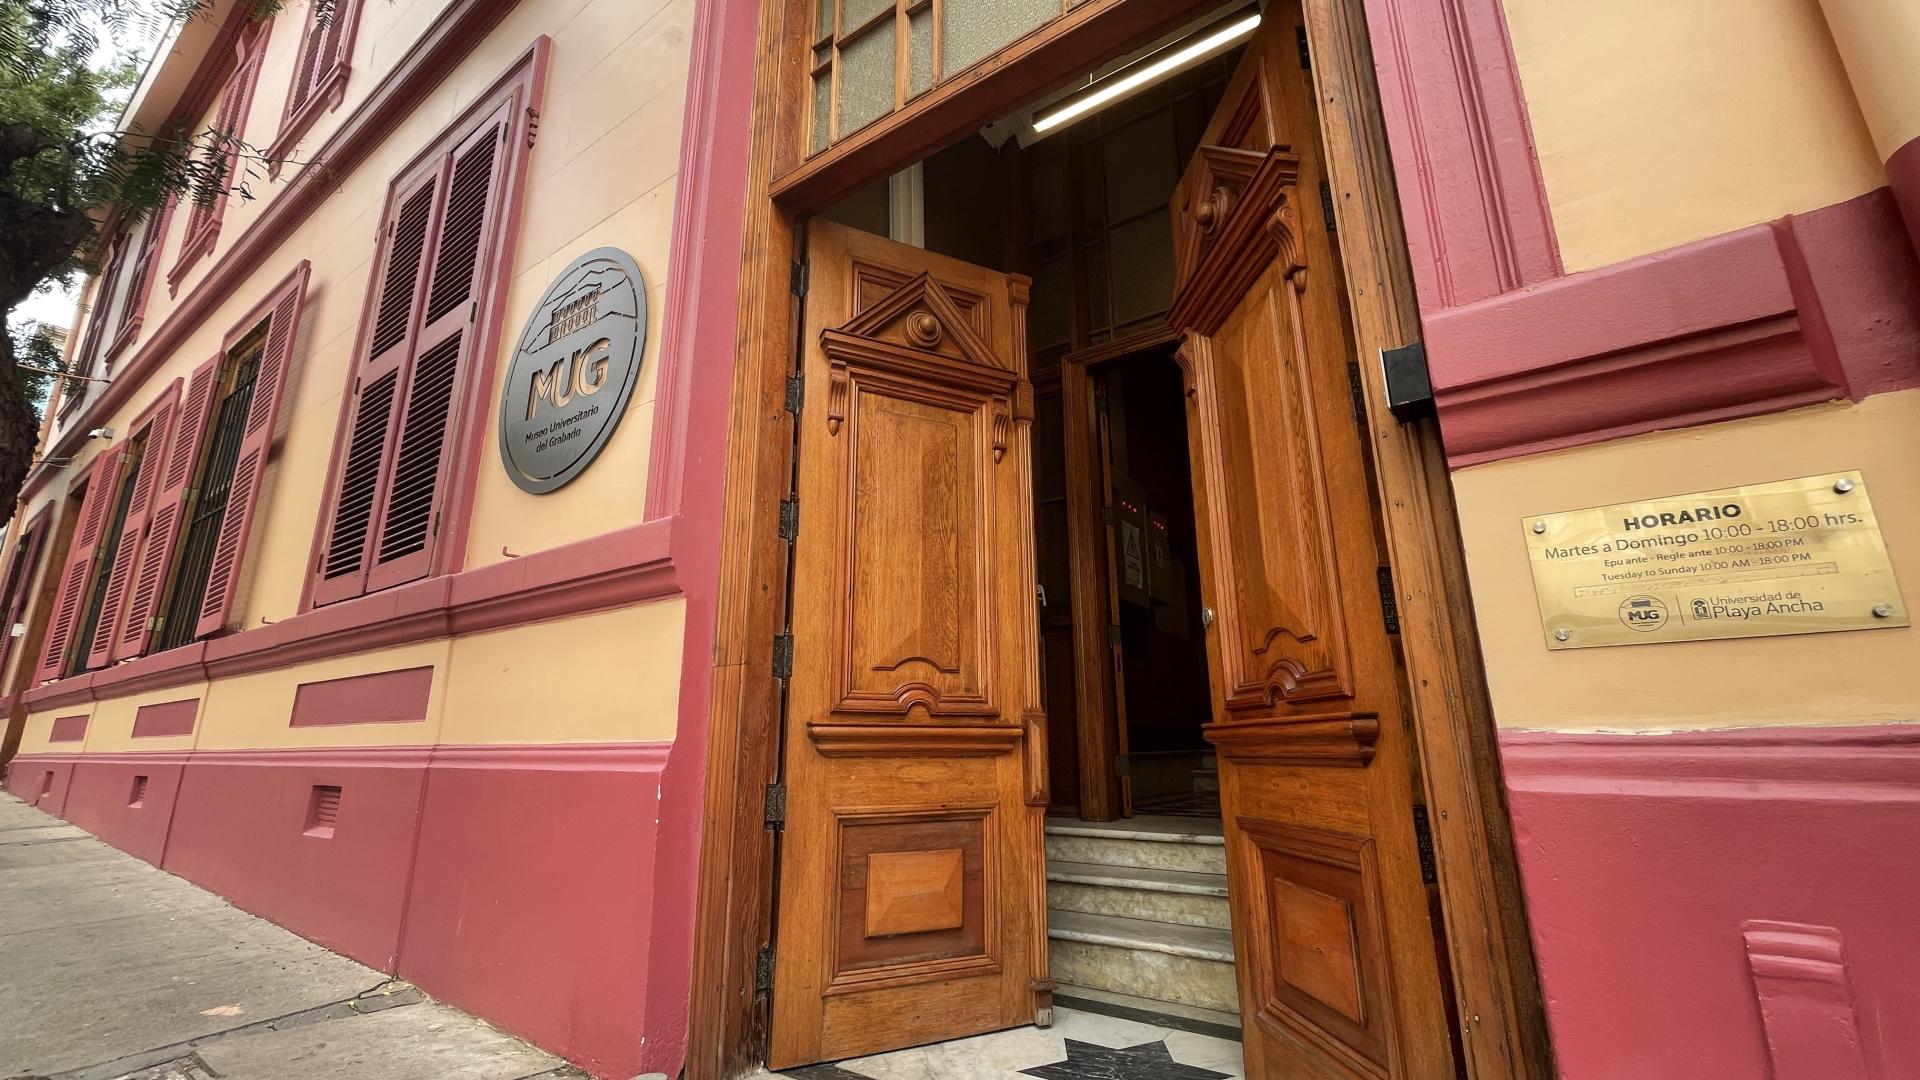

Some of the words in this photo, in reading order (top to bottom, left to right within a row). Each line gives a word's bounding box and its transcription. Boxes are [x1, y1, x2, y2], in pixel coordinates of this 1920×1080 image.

[525, 337, 611, 422] MUG
[525, 427, 548, 444] Museo
[550, 405, 599, 433] Universitario
[536, 438, 548, 453] del
[549, 427, 581, 447] Grabado
[1623, 504, 1741, 531] HORARIO
[1545, 544, 1598, 560] Martes
[1603, 542, 1612, 553] a
[1616, 533, 1699, 551] Domingo
[1702, 523, 1752, 541] 10:00
[1768, 515, 1820, 533] 18:00
[1824, 512, 1863, 527] hrs.
[1602, 569, 1643, 581] Tuesday
[1645, 569, 1656, 577] to
[1658, 563, 1698, 576] Sunday
[1731, 559, 1751, 568] AM
[1791, 552, 1811, 561] PM
[1604, 559, 1624, 568] Epu
[1625, 556, 1648, 565] ante
[1656, 551, 1686, 562] Regle
[1688, 549, 1713, 559] ante
[1714, 544, 1744, 555] 10:00
[1753, 540, 1783, 551] 18:00
[1785, 537, 1805, 547] PM
[1710, 591, 1786, 606] Universidad
[1788, 590, 1801, 600] de
[1712, 605, 1762, 620] Playa
[1766, 599, 1824, 615] Ancha
[1628, 609, 1660, 621] MUG
